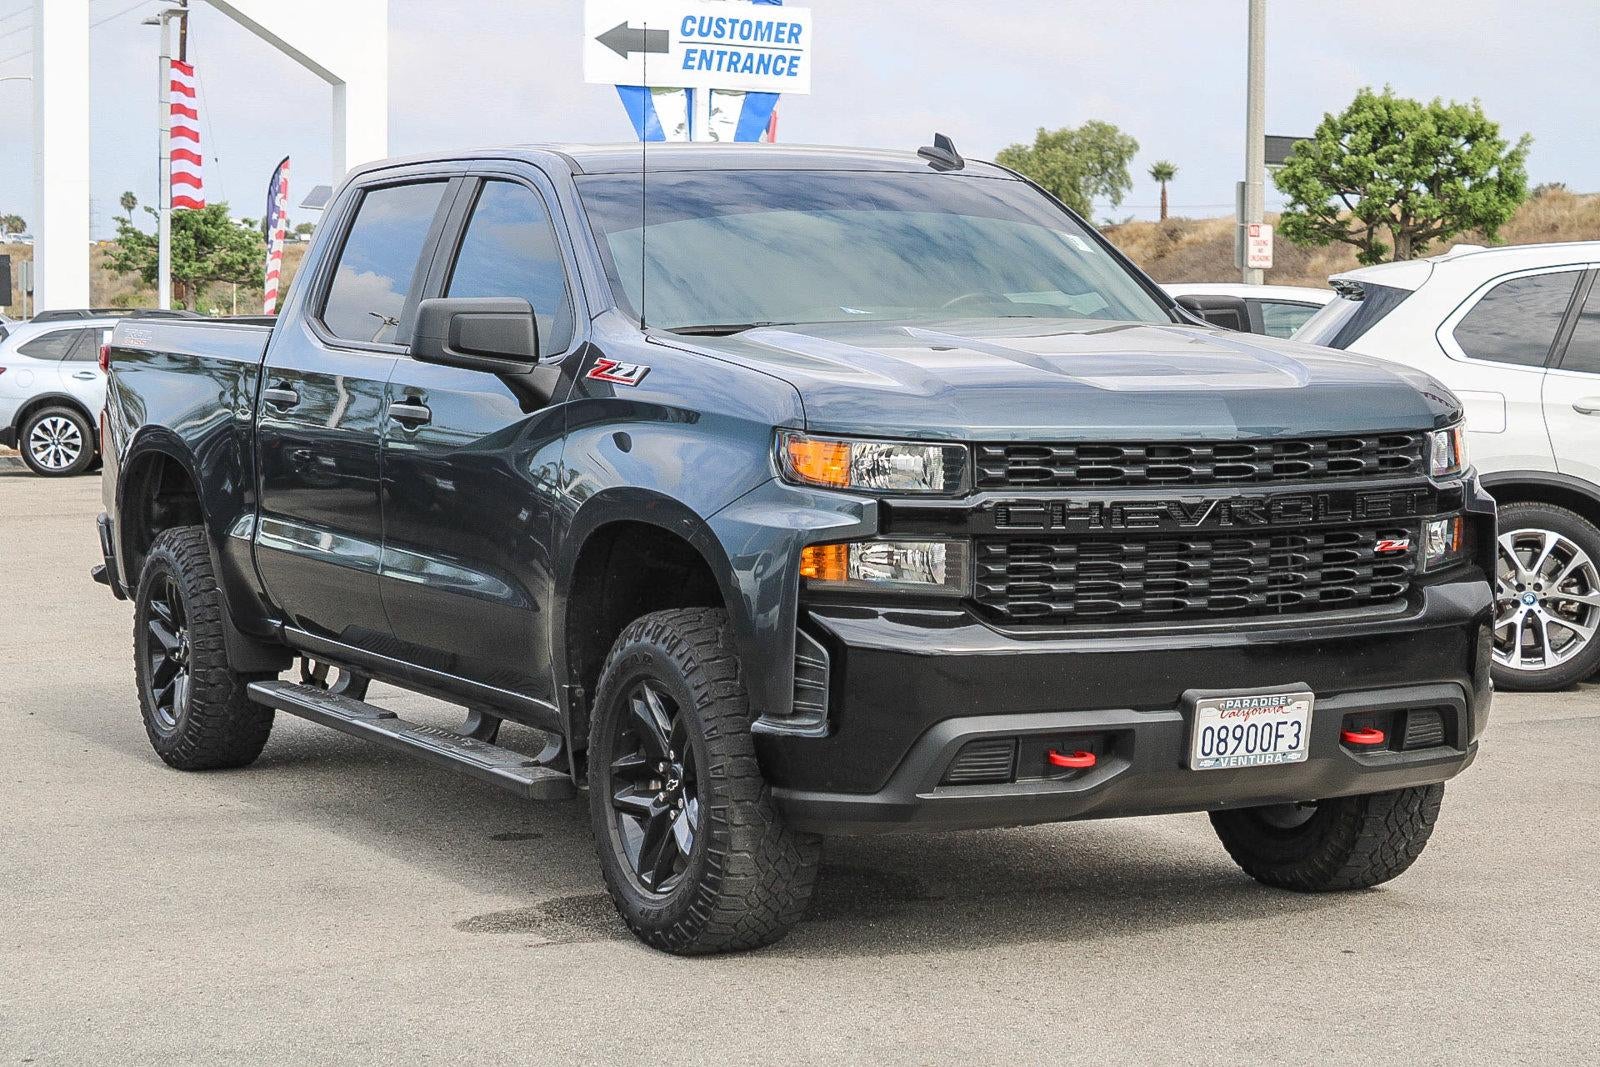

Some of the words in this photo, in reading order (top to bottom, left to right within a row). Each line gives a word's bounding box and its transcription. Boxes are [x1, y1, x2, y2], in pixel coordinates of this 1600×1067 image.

[680, 15, 803, 44] CUSTOMER
[682, 48, 801, 76] ENTRANCE
[586, 357, 651, 387] Z71
[994, 487, 1429, 530] CHEVROLET
[1373, 539, 1410, 552] Z71
[1226, 696, 1287, 709] PARADISE
[1201, 720, 1302, 757] 08900F3
[1220, 754, 1284, 767] VENTURA
